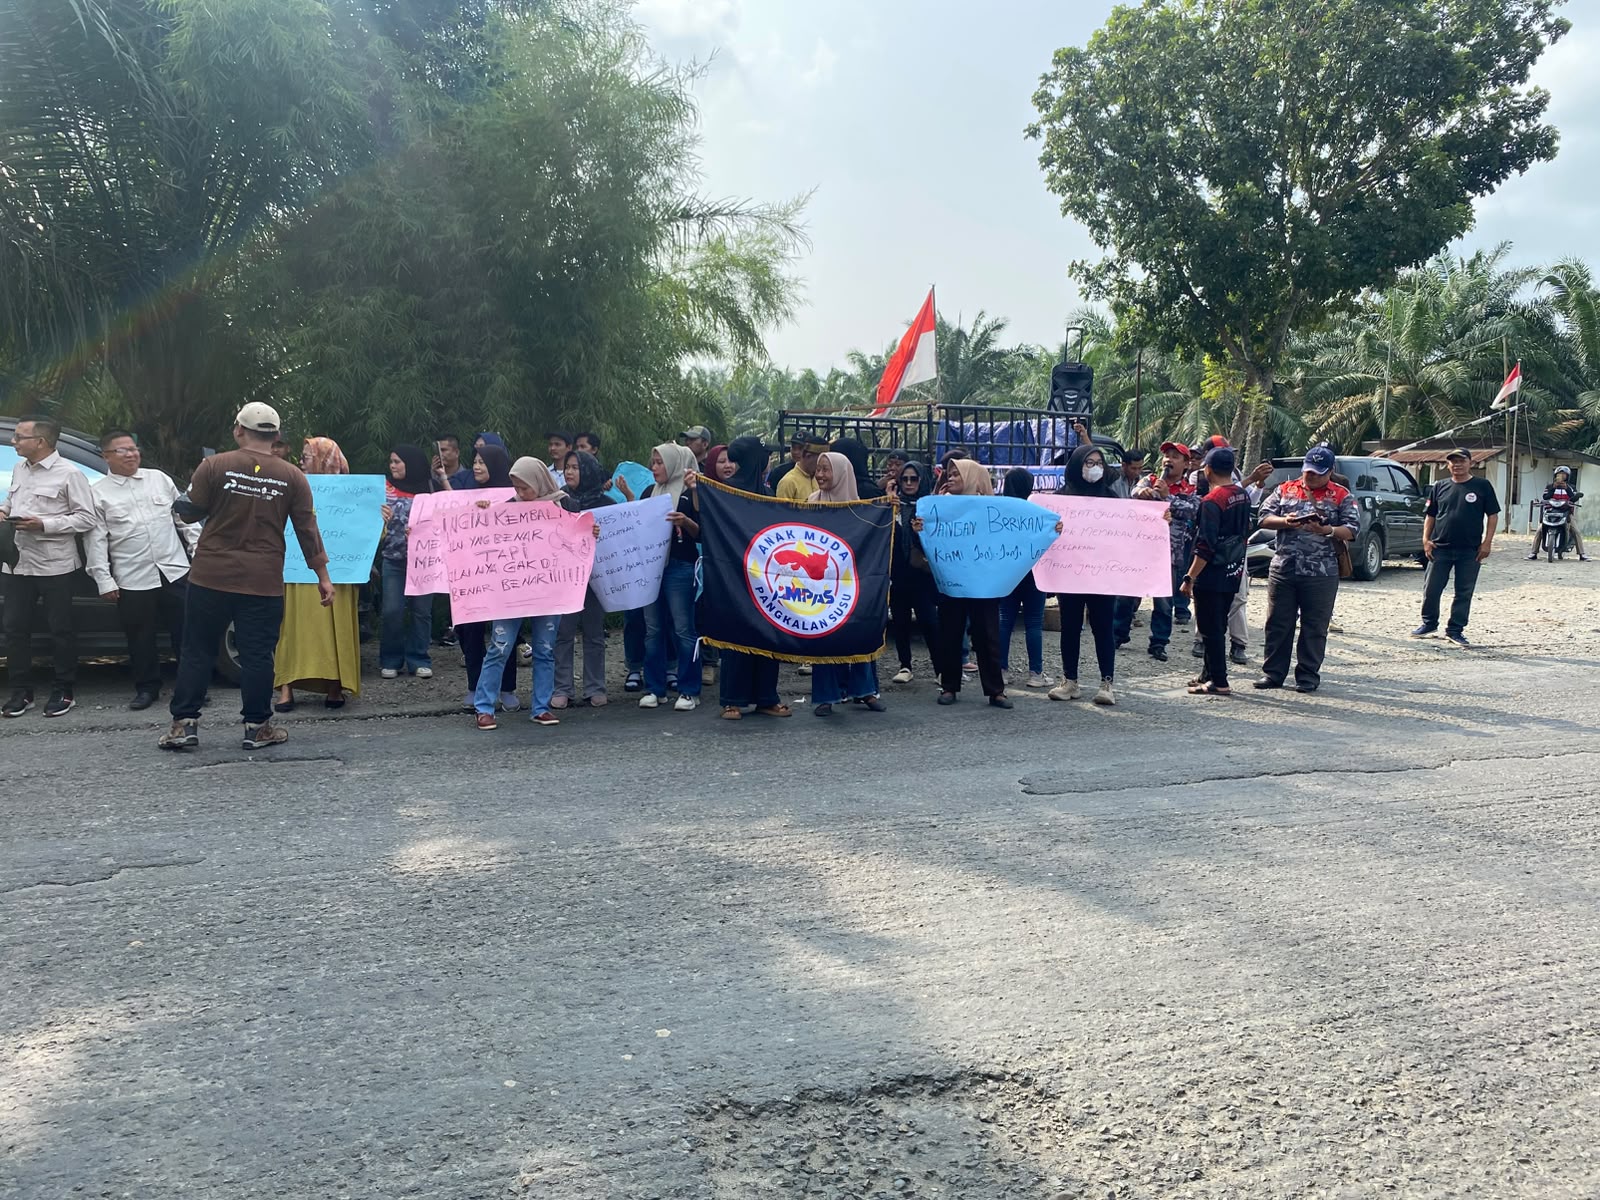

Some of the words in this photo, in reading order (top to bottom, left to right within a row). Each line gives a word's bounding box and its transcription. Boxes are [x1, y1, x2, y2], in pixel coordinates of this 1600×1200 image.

[494, 528, 544, 544] BENAR
[758, 529, 796, 555] ANAK
[804, 530, 849, 561] MUDA
[474, 542, 529, 562] TAPI
[503, 559, 537, 573] GAK
[755, 586, 828, 631] PANGKALAN
[828, 593, 852, 623] SUSU
